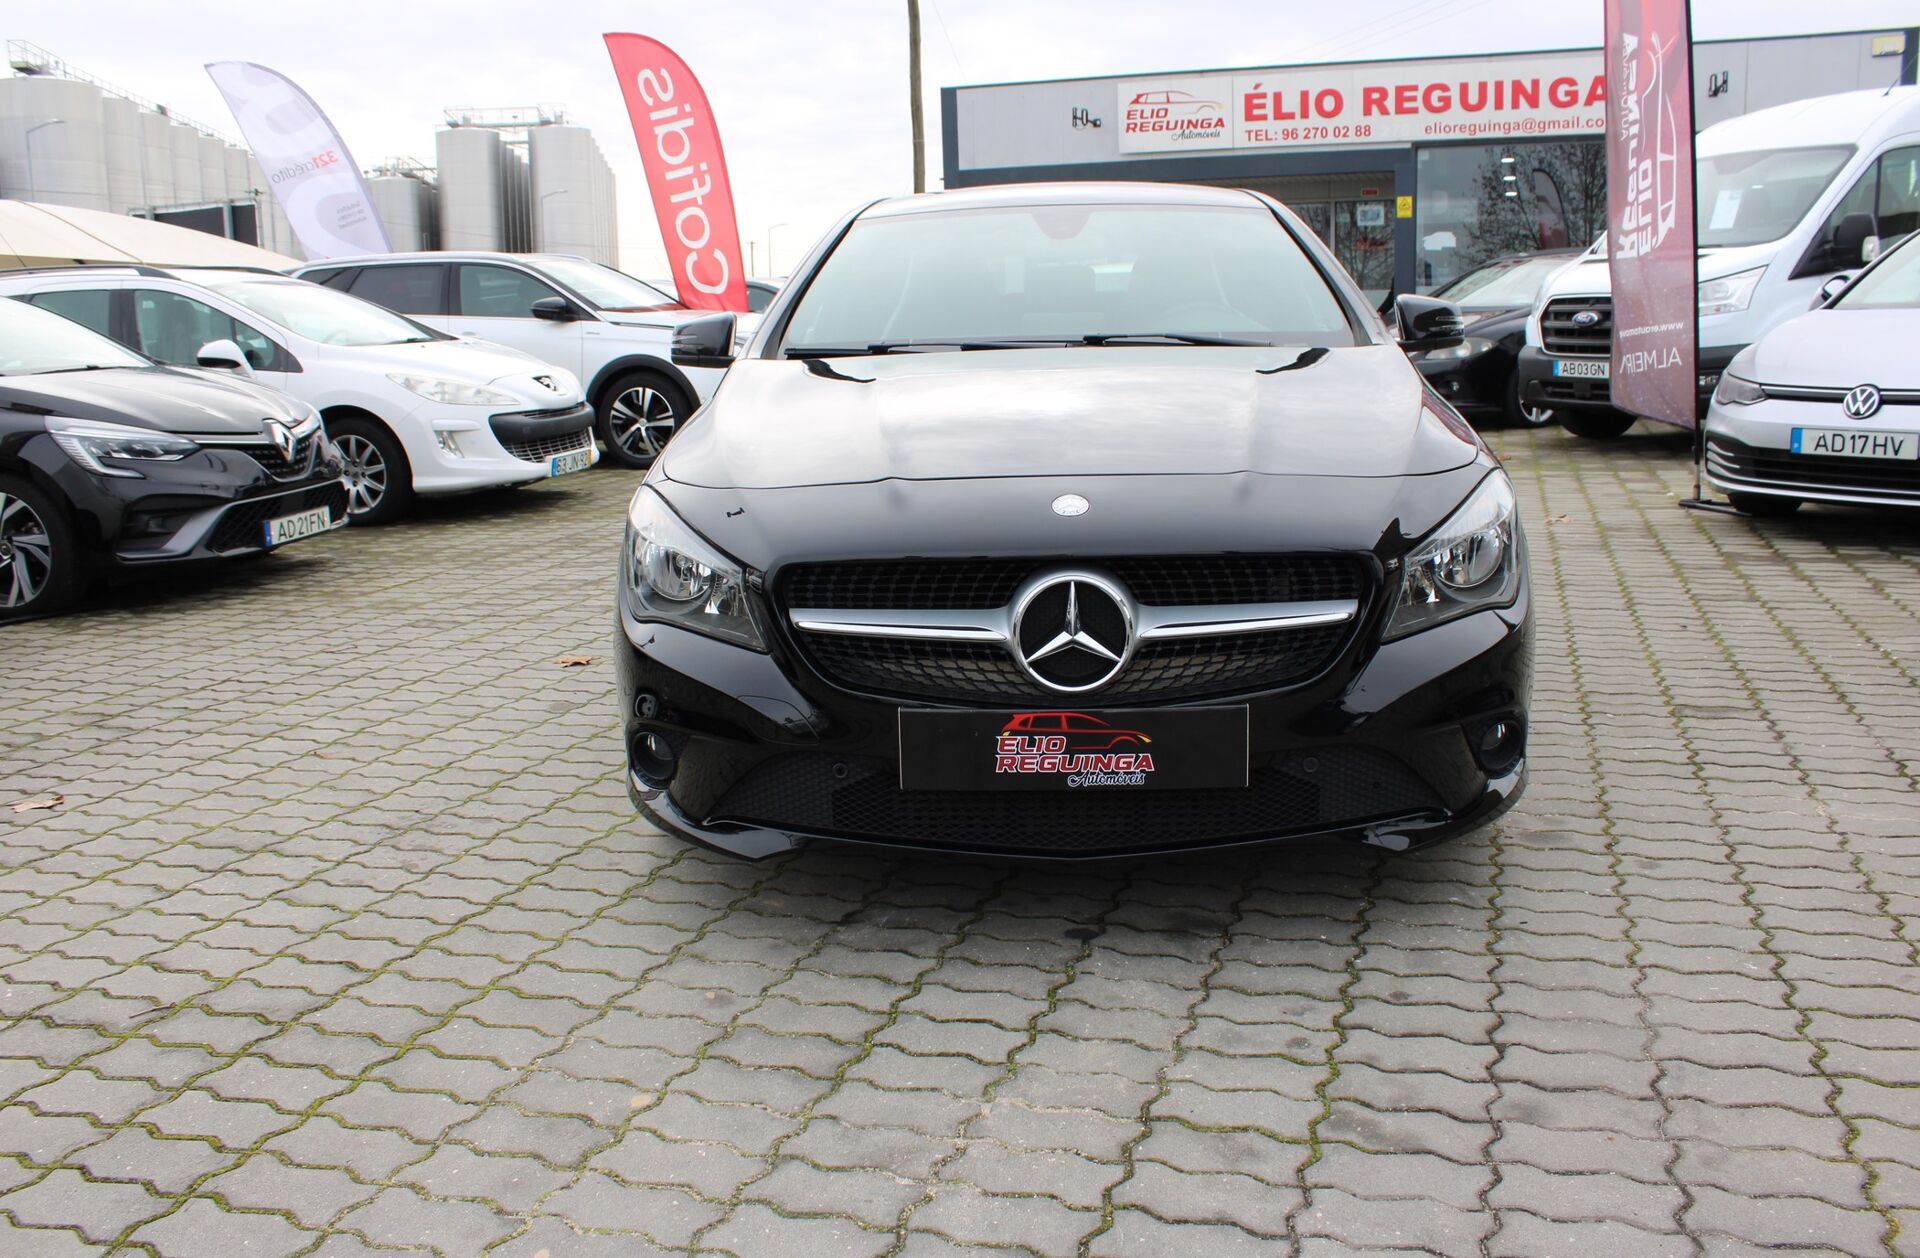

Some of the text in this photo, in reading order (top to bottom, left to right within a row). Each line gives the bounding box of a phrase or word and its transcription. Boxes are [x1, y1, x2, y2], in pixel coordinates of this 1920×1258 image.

[1244, 76, 1606, 122] ÉLIO REGUINGA
[1126, 118, 1225, 133] REGUINGA
[1245, 124, 1372, 142] TEL: 96 270 02 88
[1171, 129, 1221, 141] Automóveis
[996, 753, 1155, 773] REGUINGA
[1067, 771, 1146, 787] Automóveis
